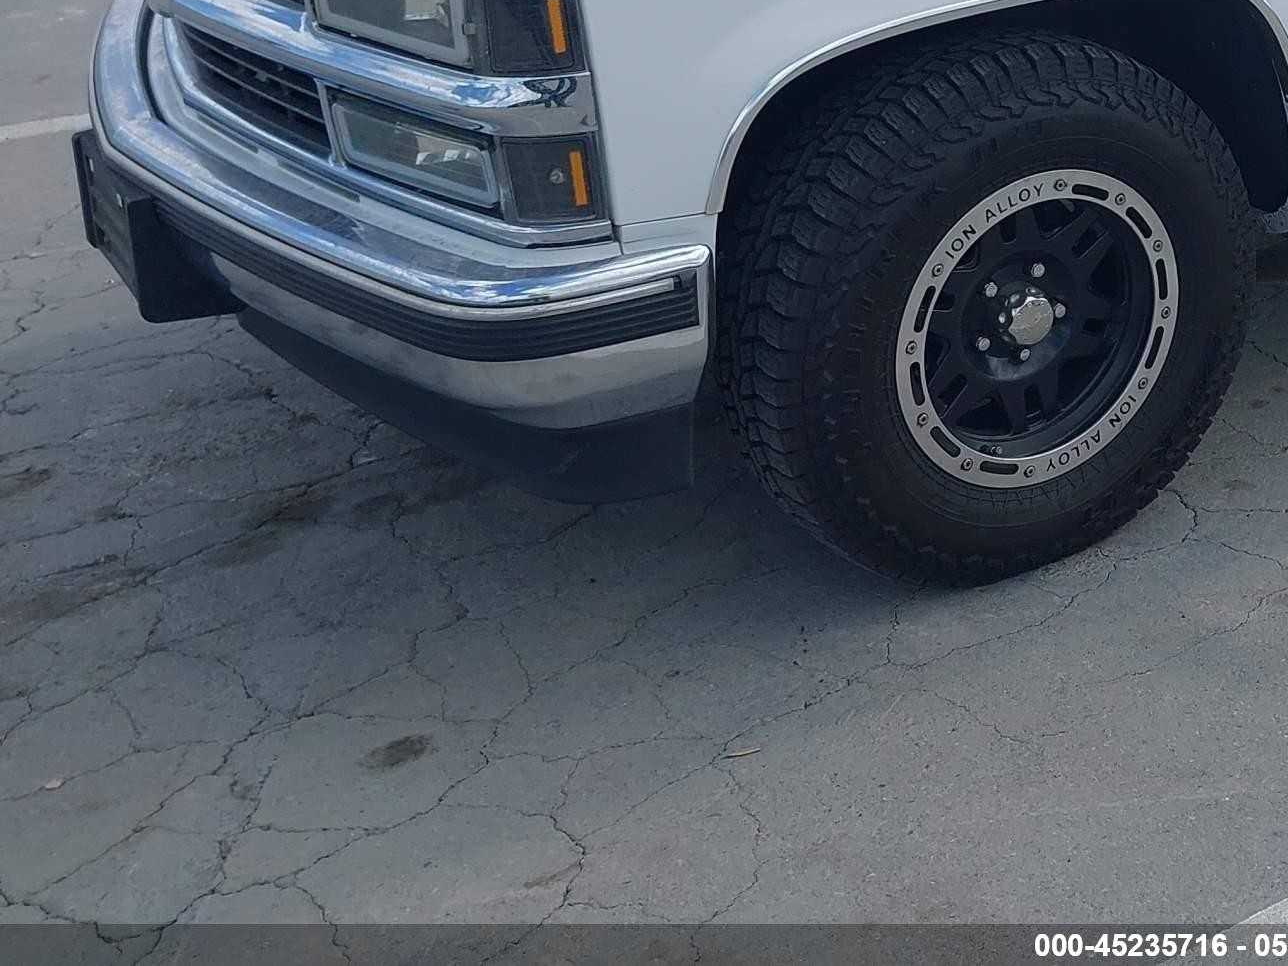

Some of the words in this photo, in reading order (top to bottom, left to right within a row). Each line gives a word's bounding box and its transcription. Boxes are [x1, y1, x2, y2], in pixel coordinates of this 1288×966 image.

[945, 224, 977, 260] ION
[985, 183, 1044, 224] ALLOY
[1108, 395, 1137, 428] ION
[1046, 429, 1102, 472] ALLOY
